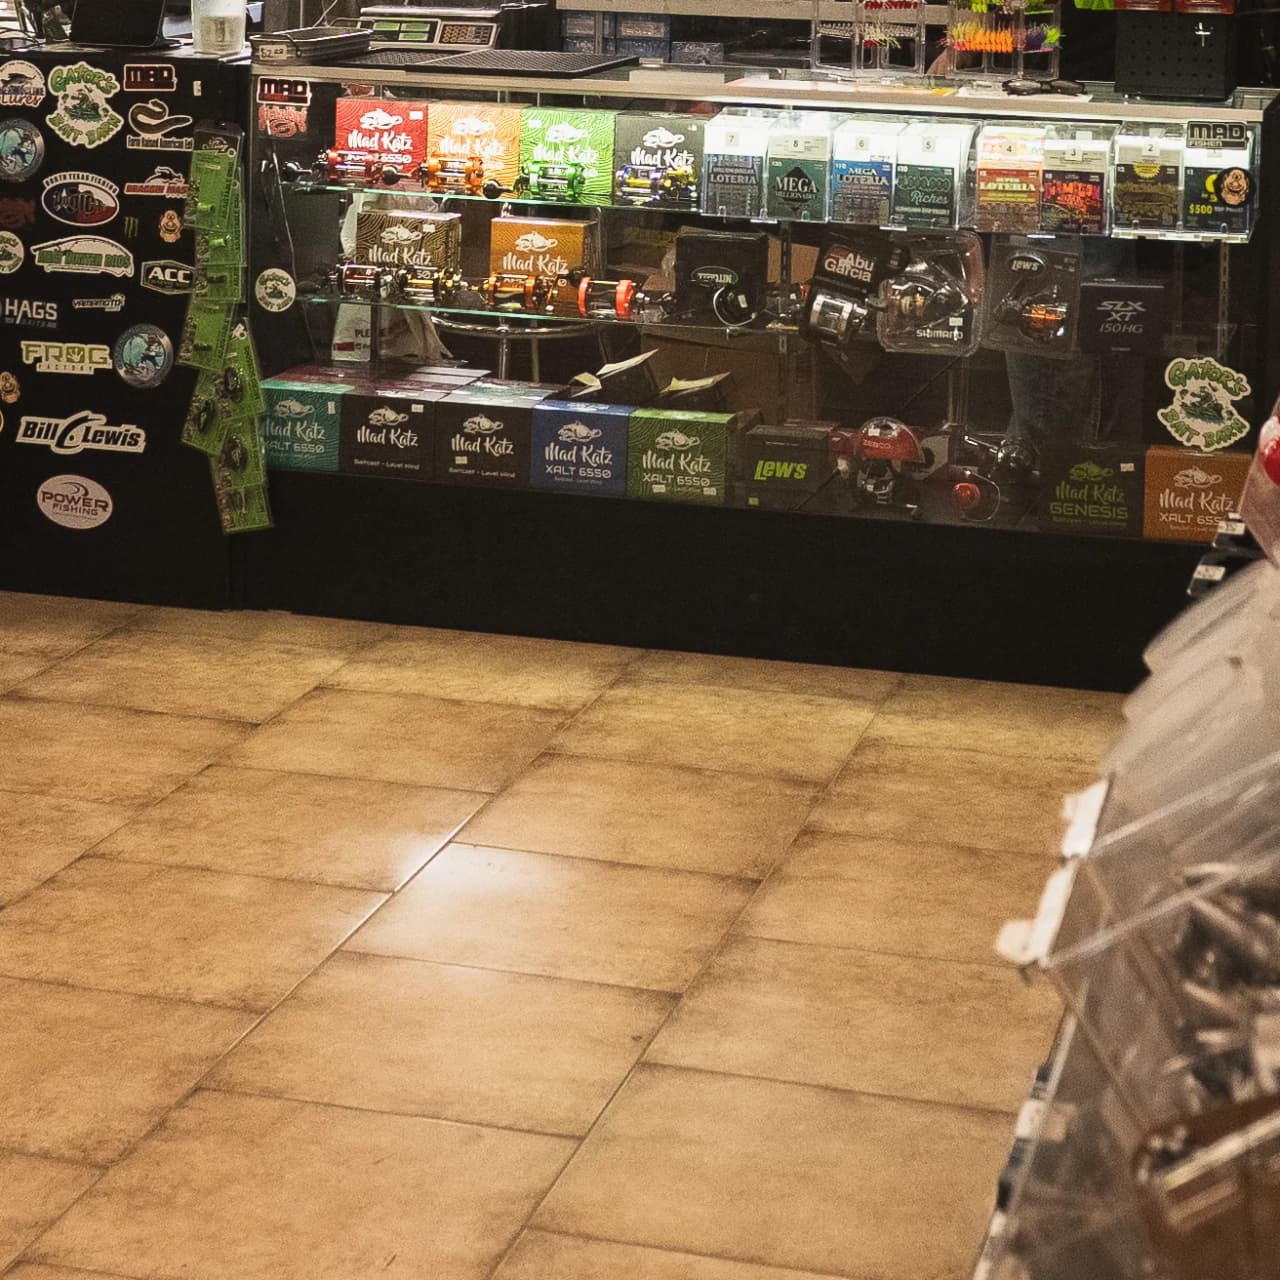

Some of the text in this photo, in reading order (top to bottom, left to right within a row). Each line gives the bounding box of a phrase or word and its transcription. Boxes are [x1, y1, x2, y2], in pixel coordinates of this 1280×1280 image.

[347, 130, 413, 152] Mad Katz
[1189, 122, 1245, 139] MAD
[439, 136, 505, 157] Mad Katz
[532, 143, 599, 163] Mad Katz
[631, 148, 695, 170] Mad Katz
[709, 174, 757, 185] LOTERIA
[776, 177, 818, 194] MEGA
[1189, 204, 1213, 215] $500
[369, 244, 433, 266] Mad Katz
[503, 252, 569, 275] Mad Katz
[846, 252, 874, 271] Abu
[148, 266, 191, 284] ACC
[825, 257, 872, 282] Garcia
[1107, 311, 1137, 322] XT
[1099, 323, 1145, 334] 150HG
[22, 342, 111, 365] FROG
[1168, 361, 1249, 397] GATOR'S
[23, 421, 142, 447] Bill Lewis
[295, 421, 326, 443] Katz
[357, 426, 419, 448] Mad Katz
[1162, 409, 1248, 450] BAIT BARN
[294, 443, 325, 454] 6550
[451, 434, 514, 457] Mad Katz
[545, 442, 613, 468] Mad Katz
[545, 464, 612, 480] XALT 6550
[642, 450, 711, 476] Mad Katz
[643, 472, 711, 487] XALT 6550
[40, 490, 109, 513] POWER
[1056, 480, 1125, 505] Mad Katz
[1159, 489, 1235, 515] Mad Katz
[52, 503, 99, 517] FISHING
[1049, 502, 1129, 520] GENESIS
[1159, 511, 1194, 524] XALT
